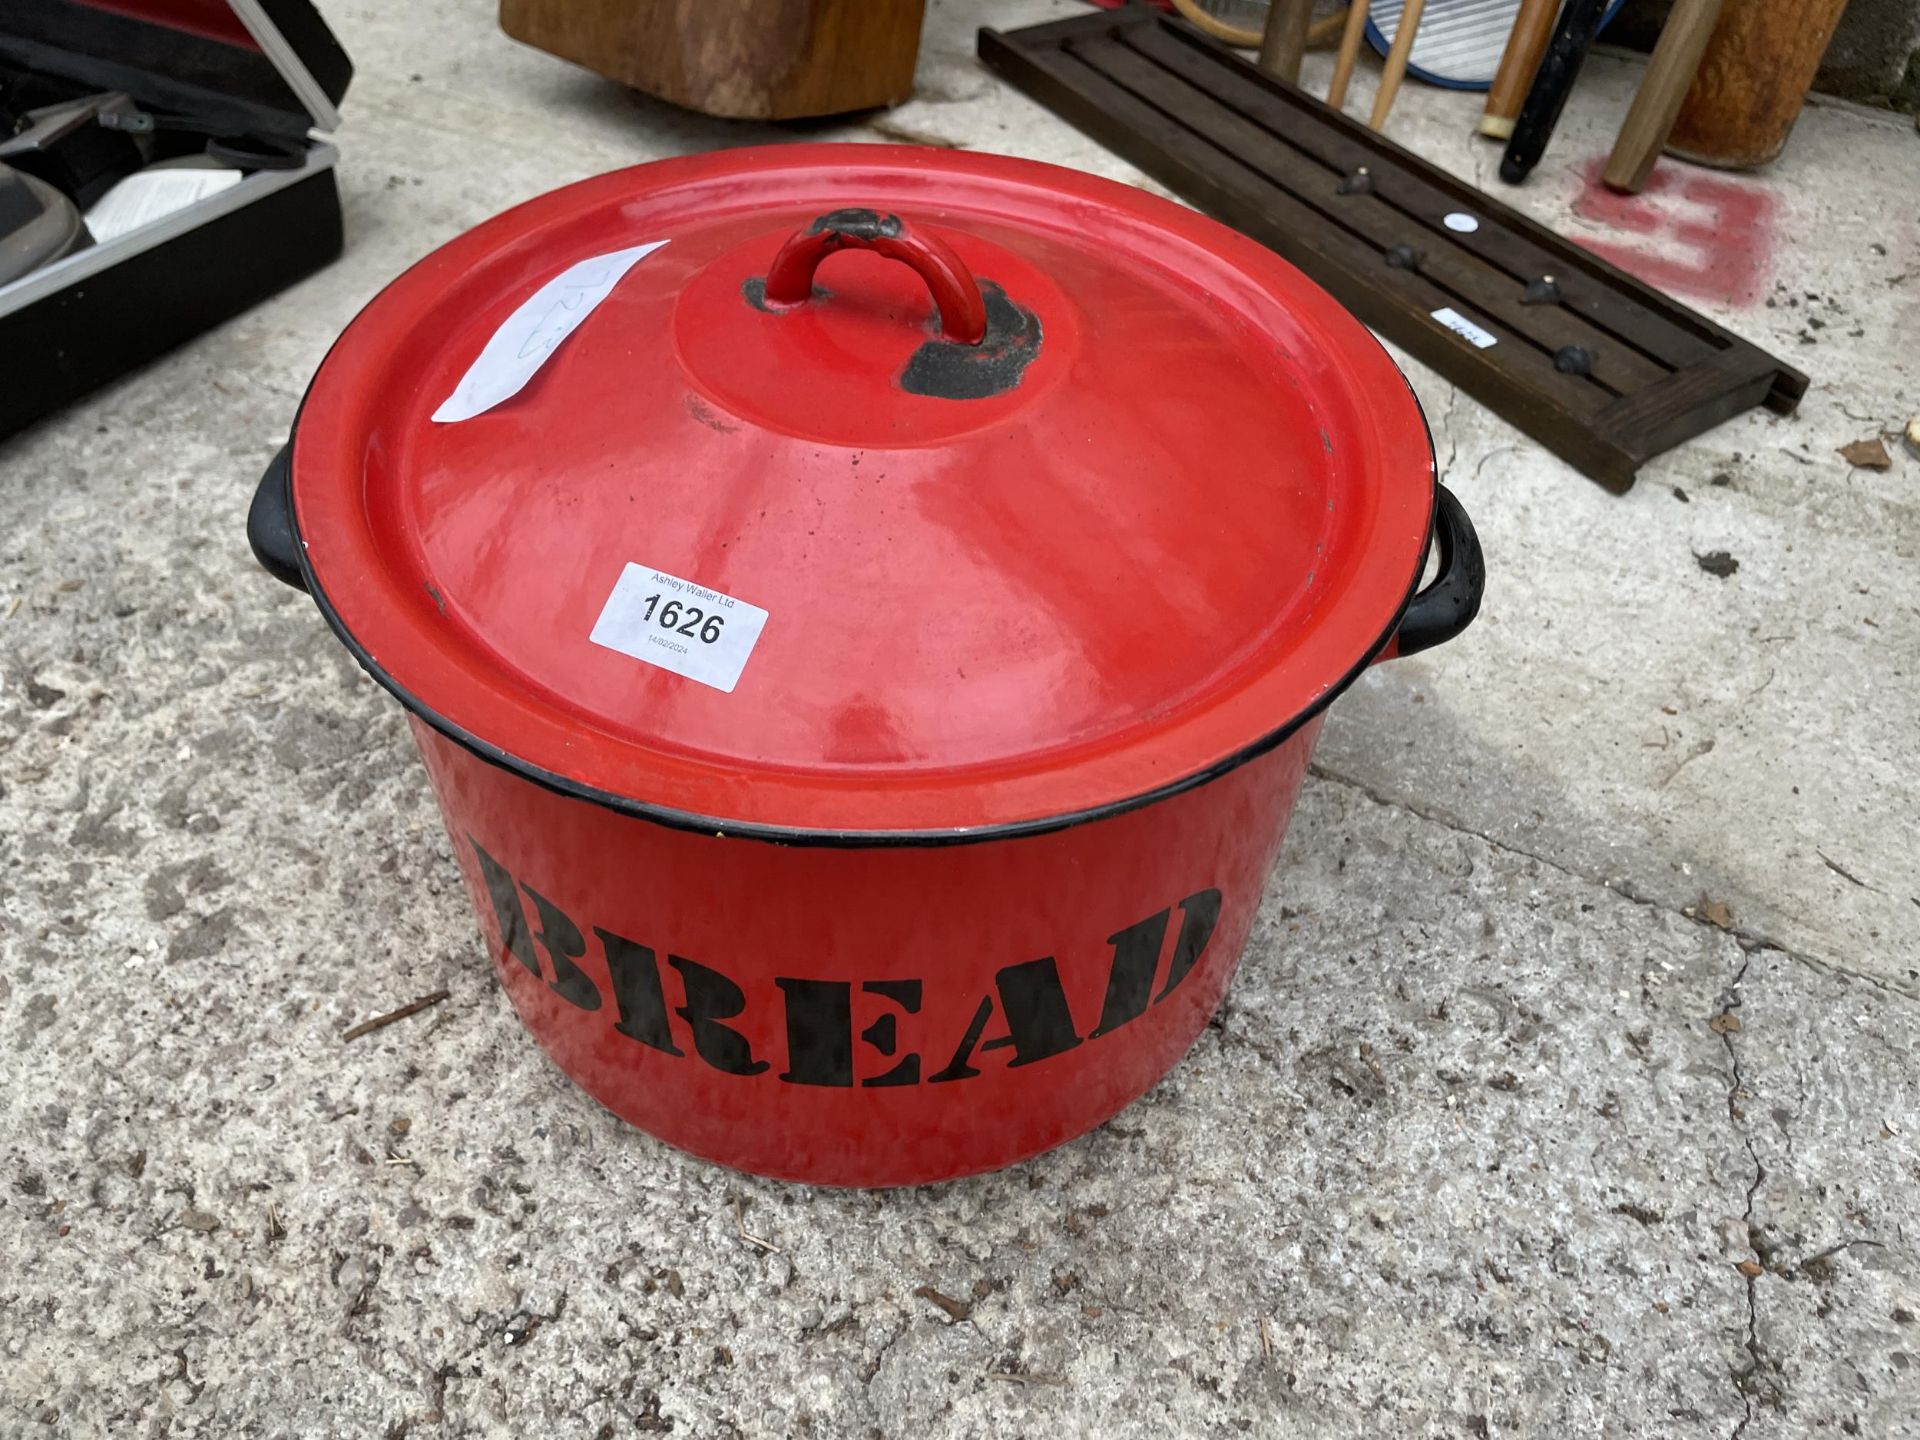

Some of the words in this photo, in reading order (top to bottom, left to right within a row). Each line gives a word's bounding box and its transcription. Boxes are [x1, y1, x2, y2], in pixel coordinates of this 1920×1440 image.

[651, 573, 684, 592] Ashley
[687, 584, 718, 602] Waller
[718, 596, 735, 609] Ltd
[643, 593, 725, 644] 1626
[648, 634, 688, 655] 14/02/2024
[466, 833, 1223, 1089] BREAD
